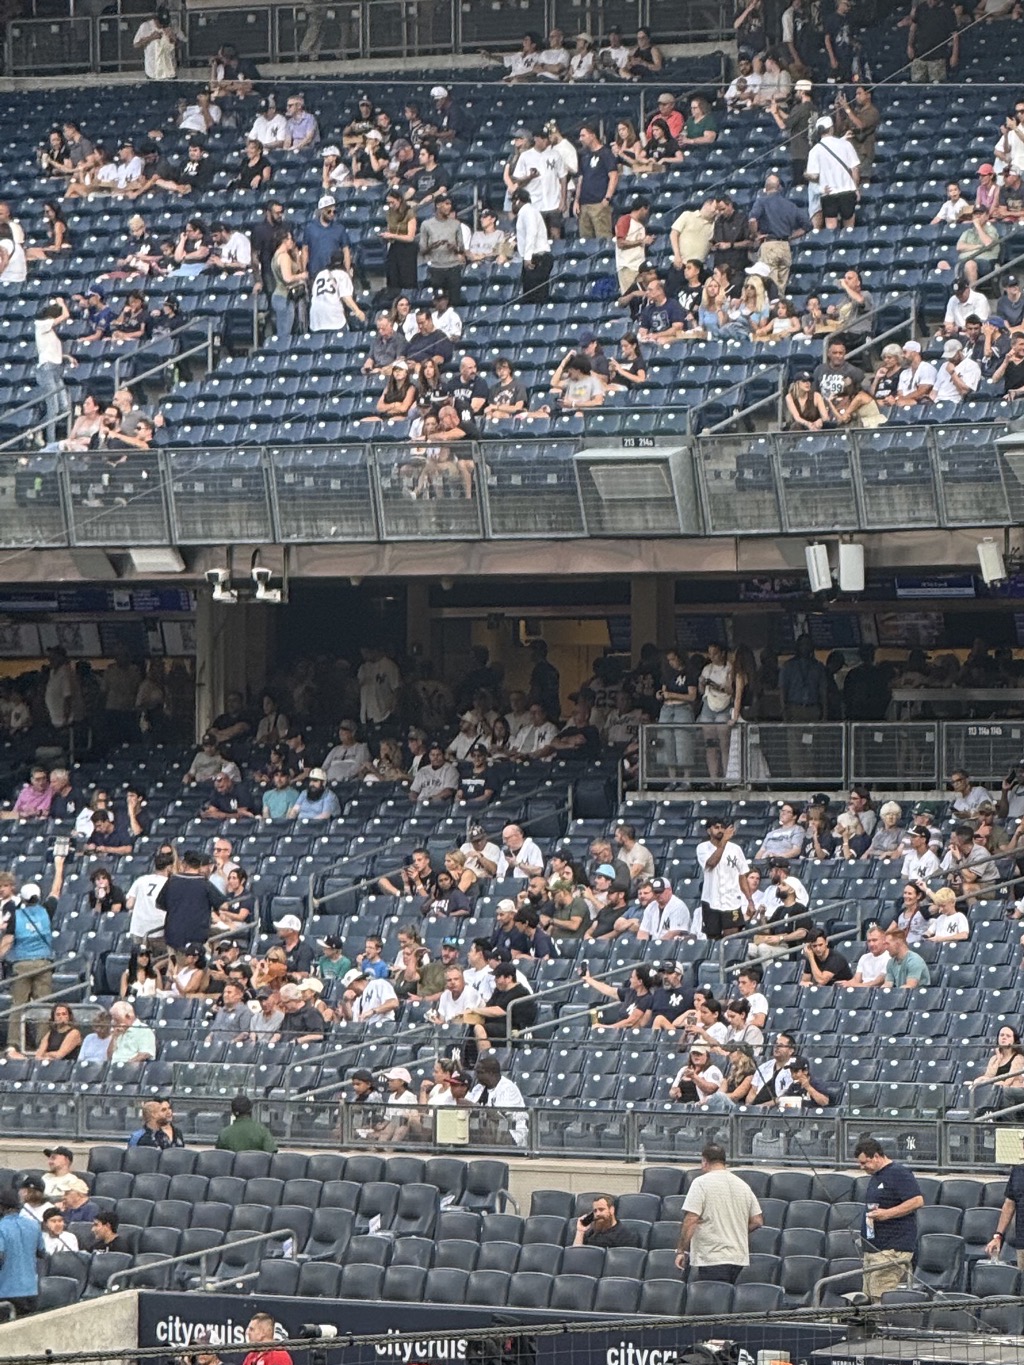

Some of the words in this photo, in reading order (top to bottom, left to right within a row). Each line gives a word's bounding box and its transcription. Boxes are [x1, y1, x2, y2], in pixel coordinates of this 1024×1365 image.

[316, 277, 336, 295] 23
[623, 438, 634, 447] 213
[638, 438, 653, 447] 214a
[675, 674, 687, 686] NY
[536, 729, 547, 743] NY
[725, 854, 739, 868] NY
[147, 882, 157, 896] 7
[945, 920, 960, 934] NY
[668, 992, 683, 1008] NY
[905, 1134, 917, 1150] NY
